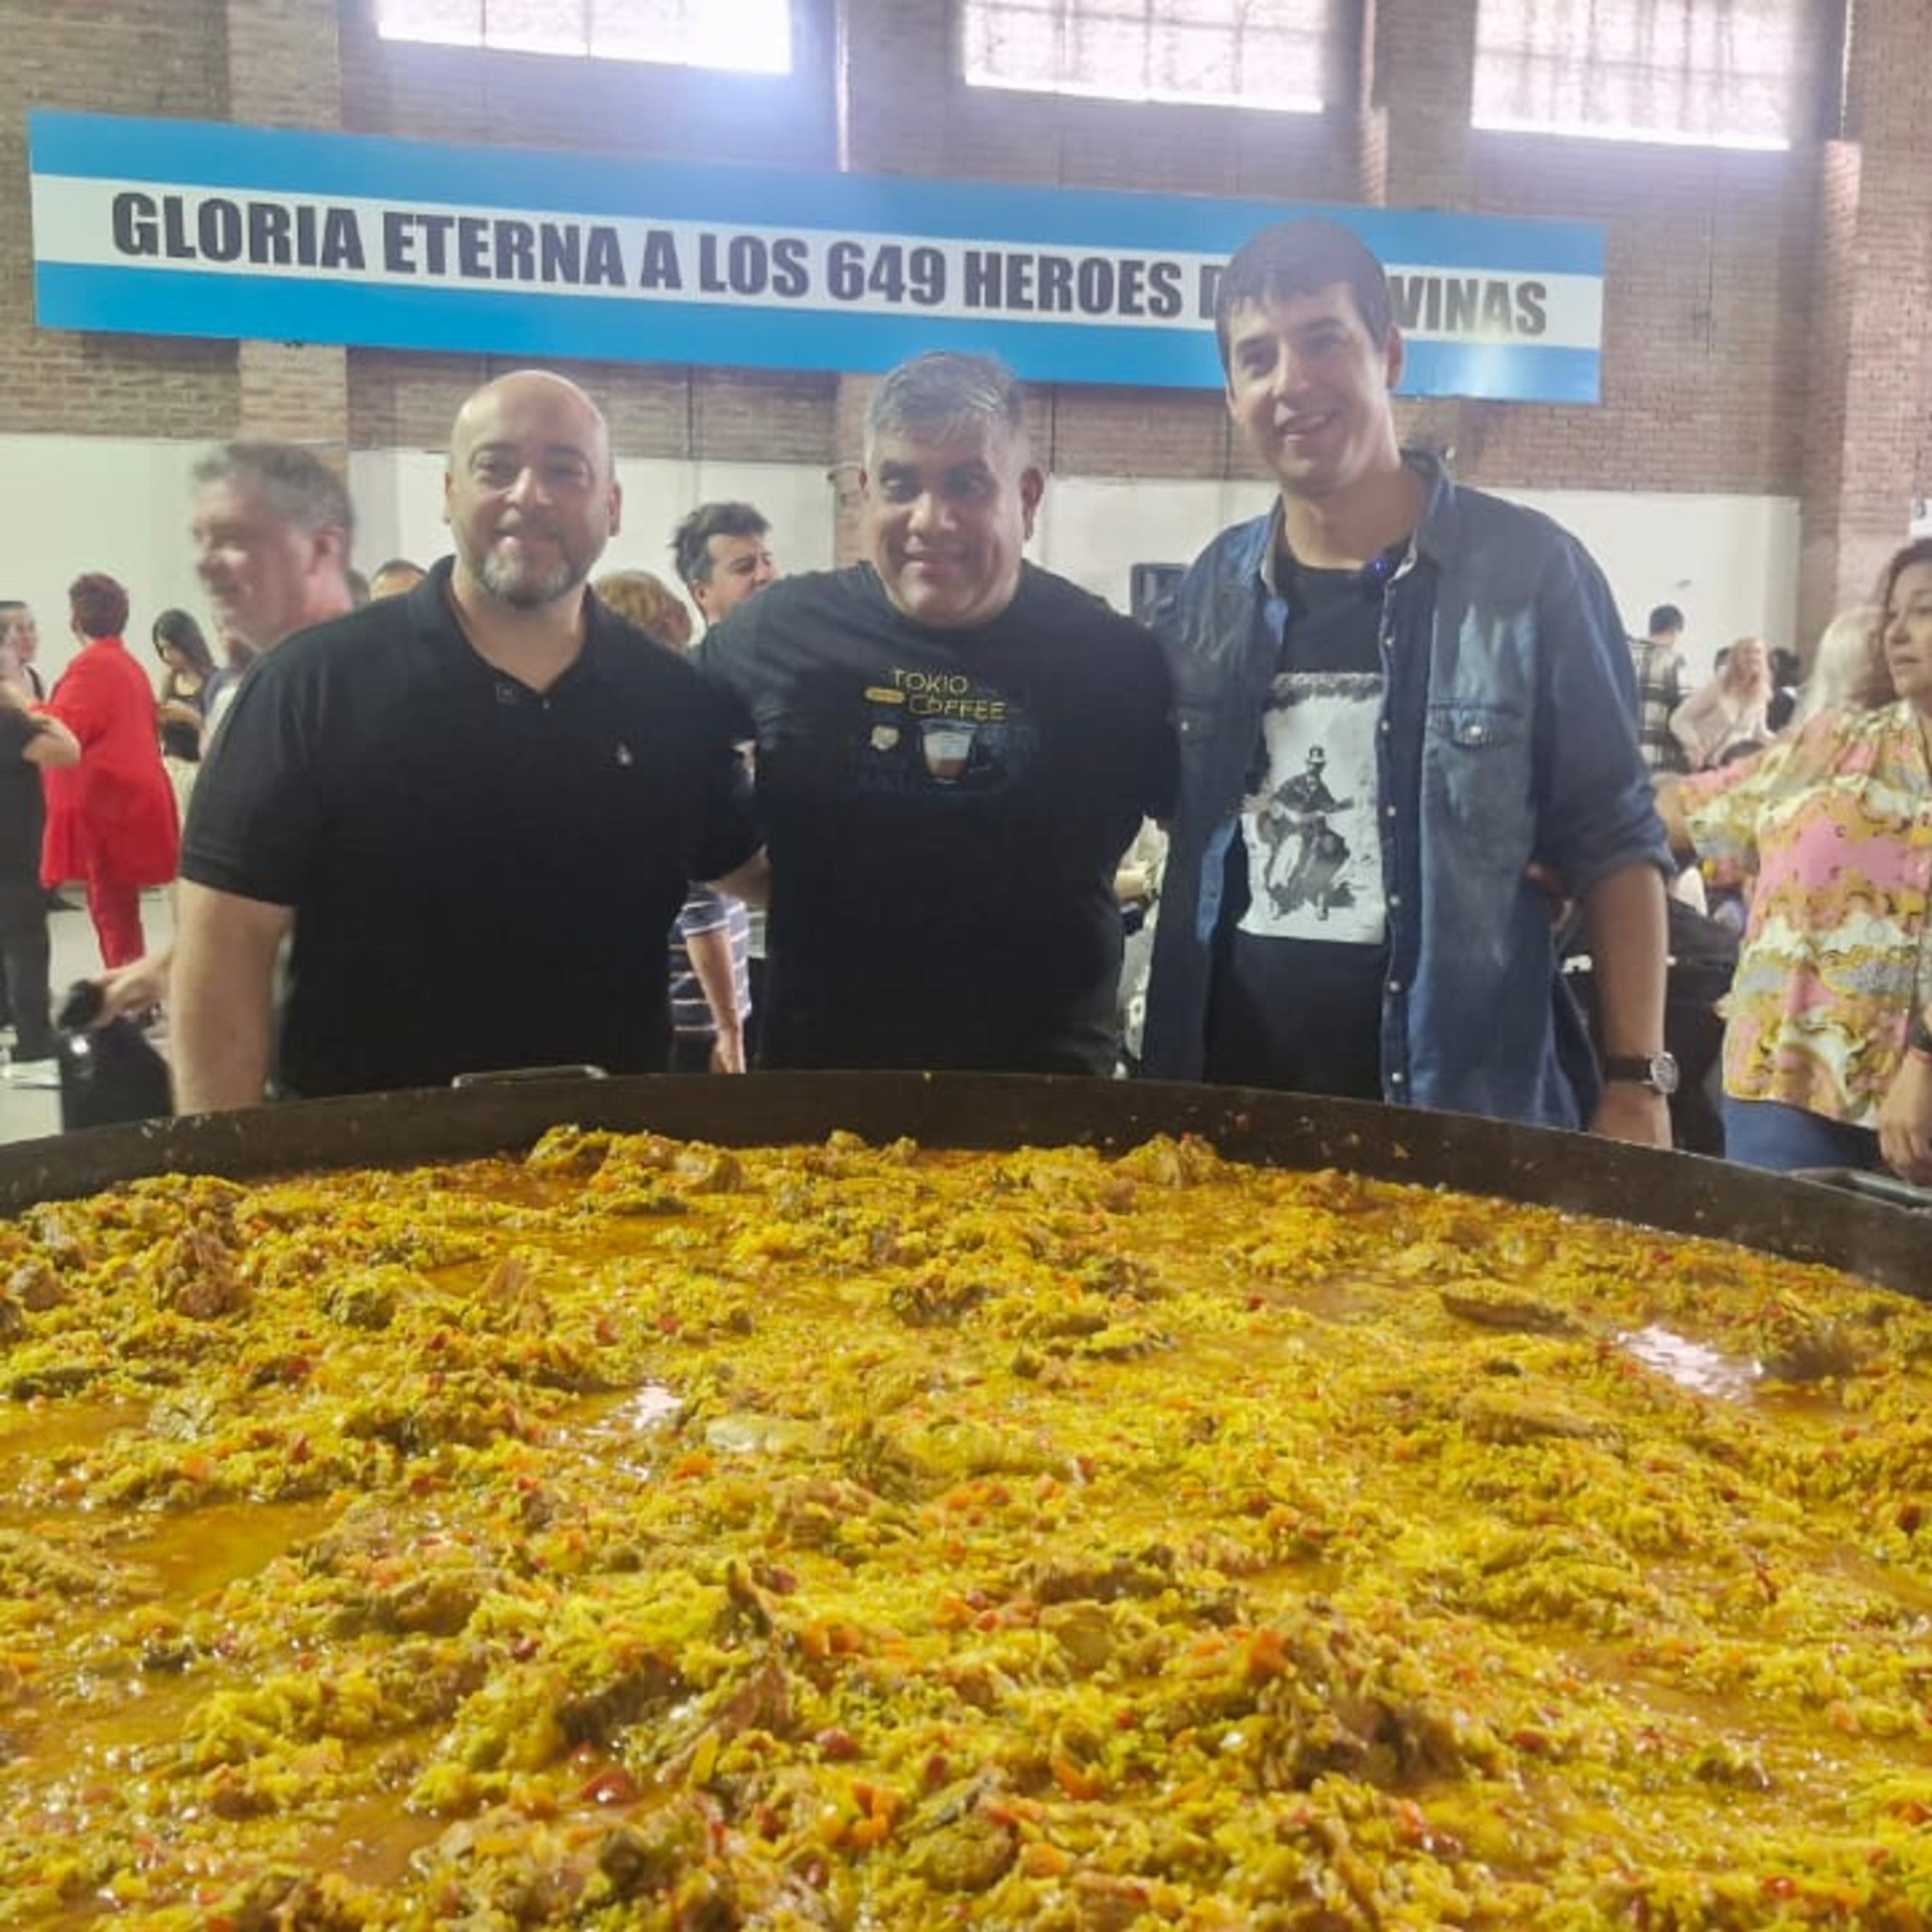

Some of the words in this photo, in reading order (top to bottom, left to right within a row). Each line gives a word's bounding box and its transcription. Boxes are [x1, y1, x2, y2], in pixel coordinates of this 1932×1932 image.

[112, 192, 366, 270] GLORIA
[383, 211, 627, 289] ETERNA
[640, 231, 683, 290] A
[699, 233, 810, 299] LOS
[827, 241, 946, 306] 649
[963, 251, 1182, 319] HEROES
[1389, 276, 1547, 336] VINAS
[894, 669, 969, 694] TOKIO
[909, 694, 1007, 720] COFFEE
